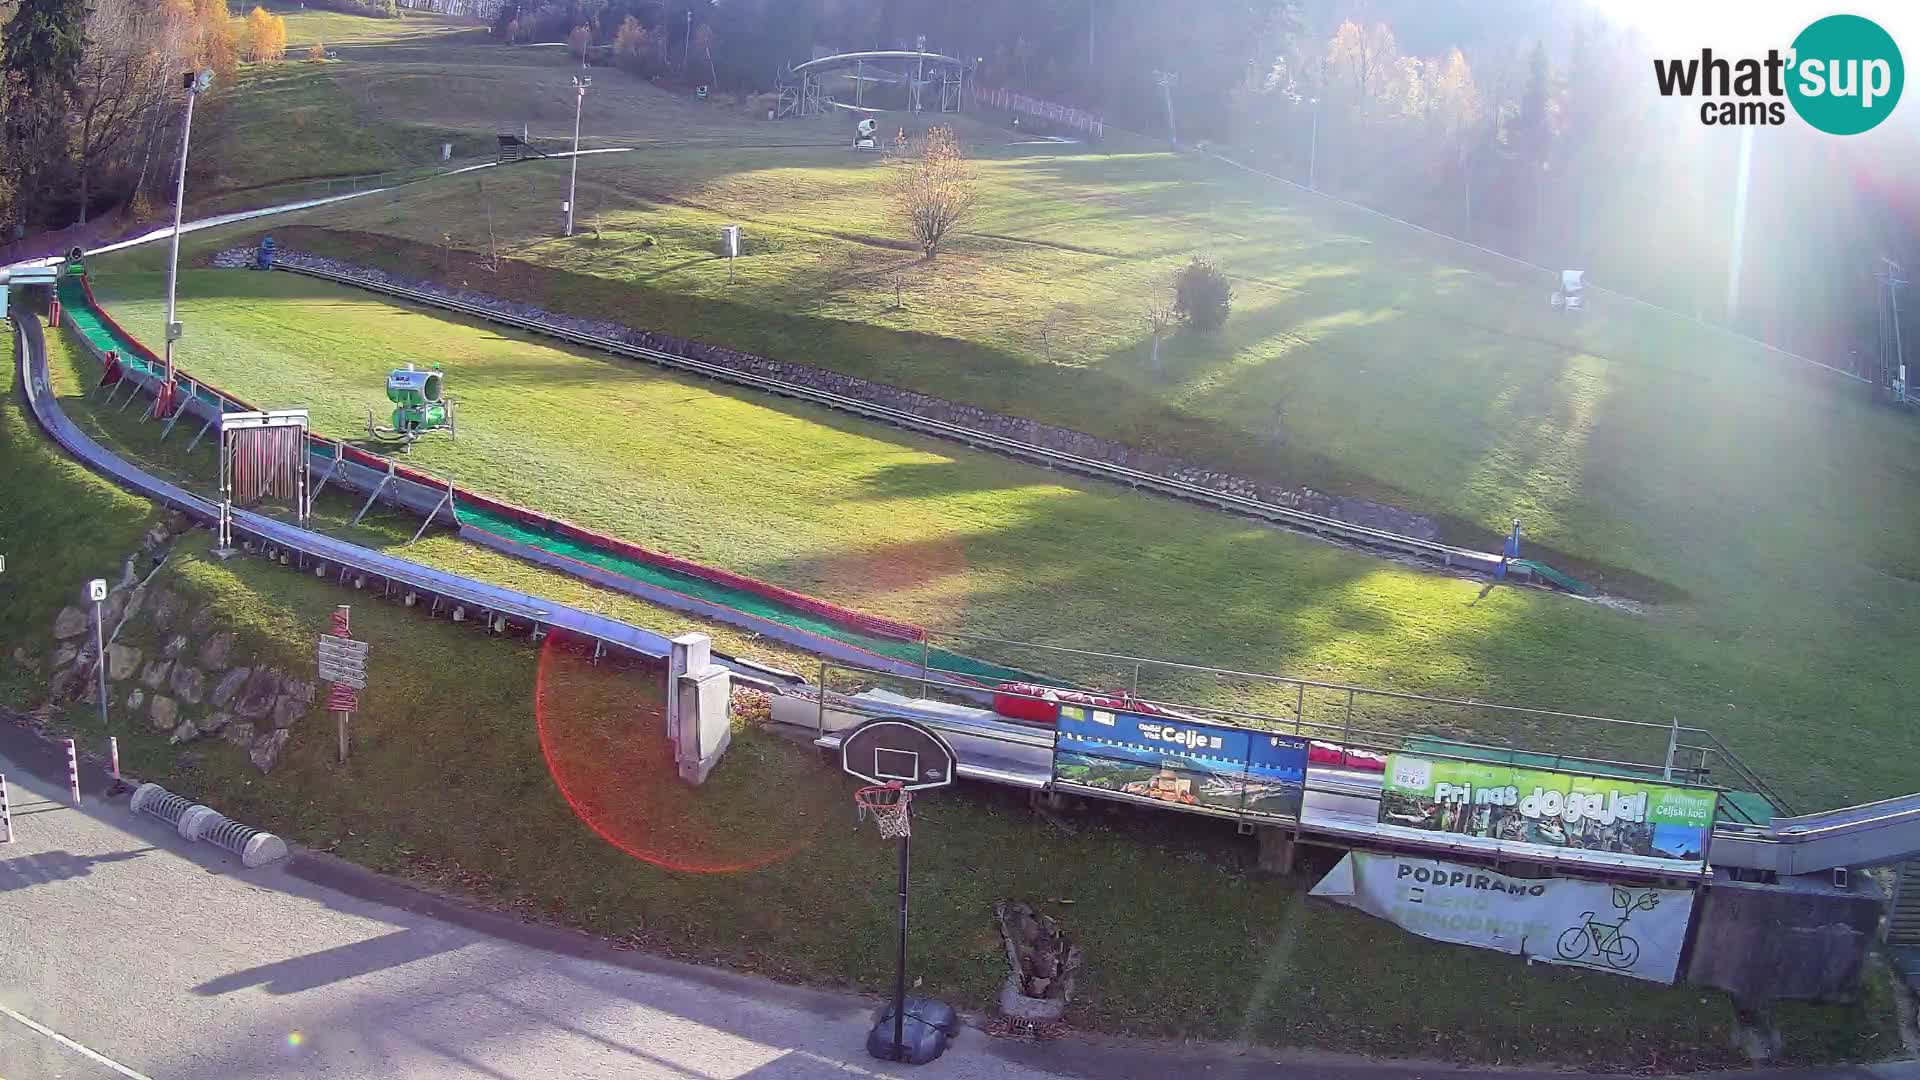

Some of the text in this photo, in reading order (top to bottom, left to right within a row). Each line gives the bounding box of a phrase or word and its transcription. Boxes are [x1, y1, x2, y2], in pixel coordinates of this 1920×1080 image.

[1162, 727, 1208, 749] Celje
[1434, 782, 1471, 805] Pri
[1475, 785, 1519, 807] nas
[1397, 864, 1546, 897] PODPIRAMO
